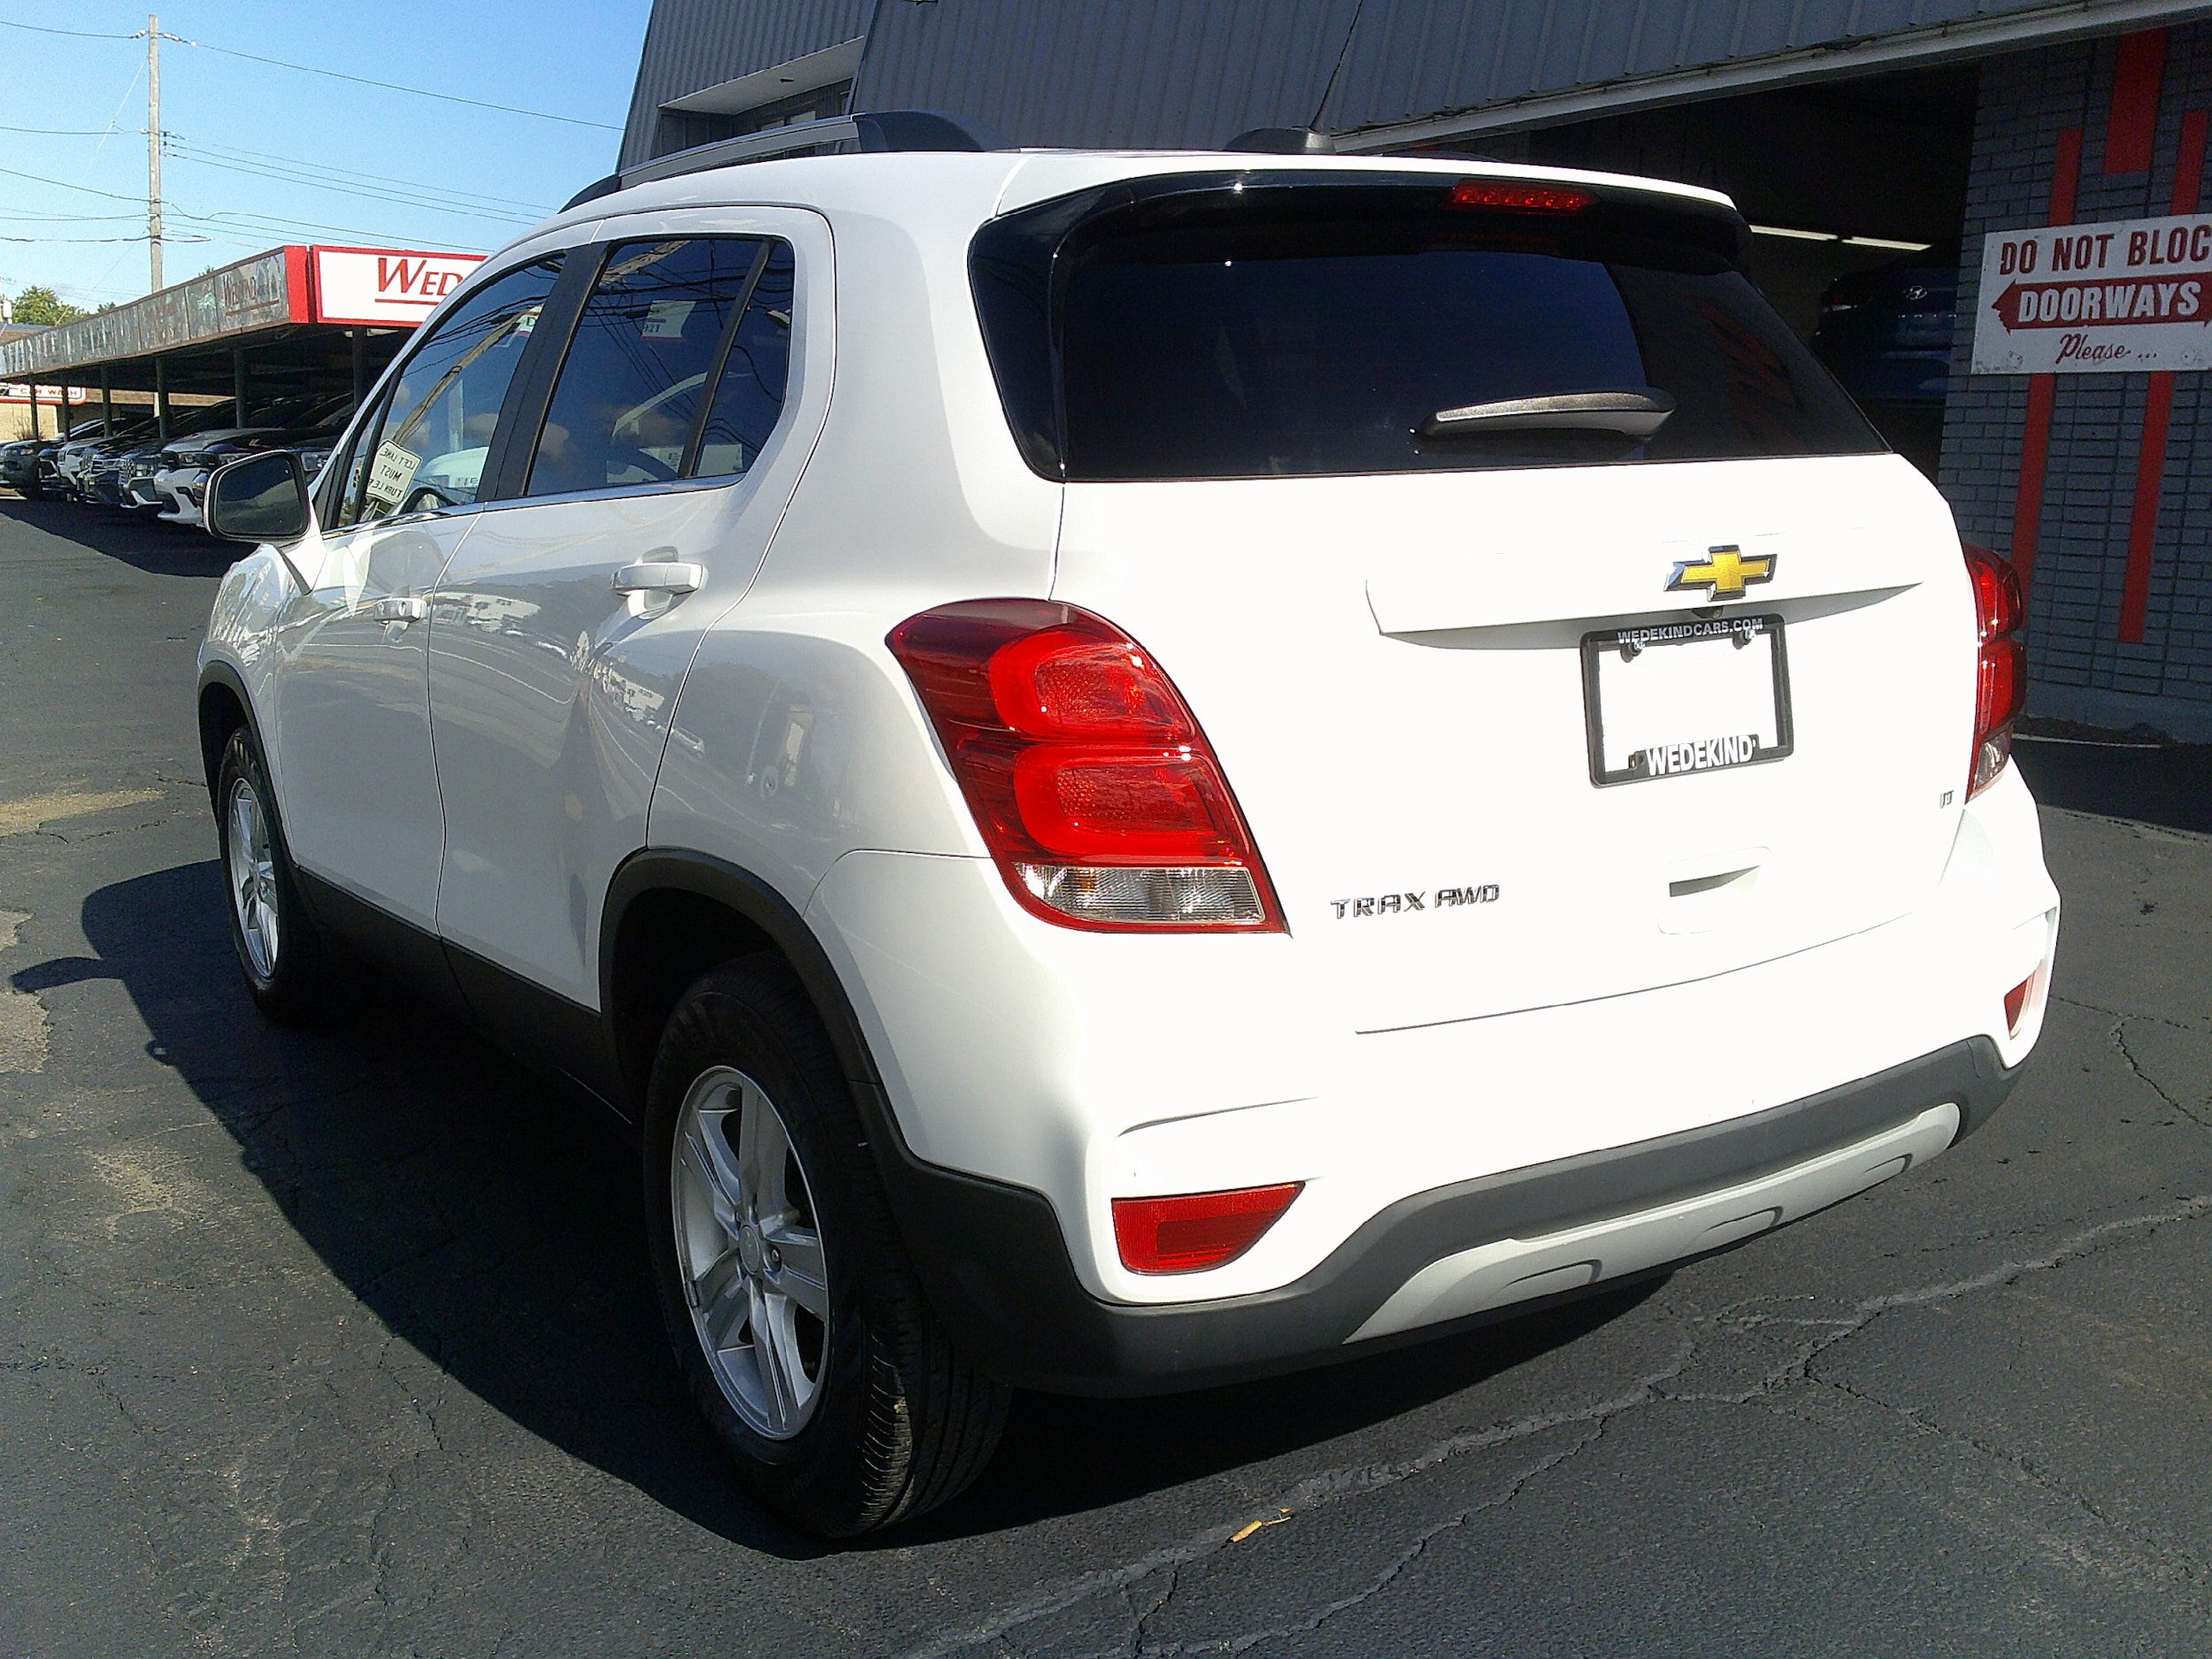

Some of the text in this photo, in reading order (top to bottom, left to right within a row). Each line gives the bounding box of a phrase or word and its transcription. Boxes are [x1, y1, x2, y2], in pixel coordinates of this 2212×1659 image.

[2000, 239, 2037, 275] DO
[2052, 233, 2115, 272] NOT
[2017, 280, 2202, 324] DOORWAYS
[2055, 333, 2131, 365] Please
[1617, 618, 1763, 644] WEDEKINDCARS.COM
[1646, 734, 1754, 776] WEDEKIND
[1330, 884, 1500, 919] TRAX AWD
